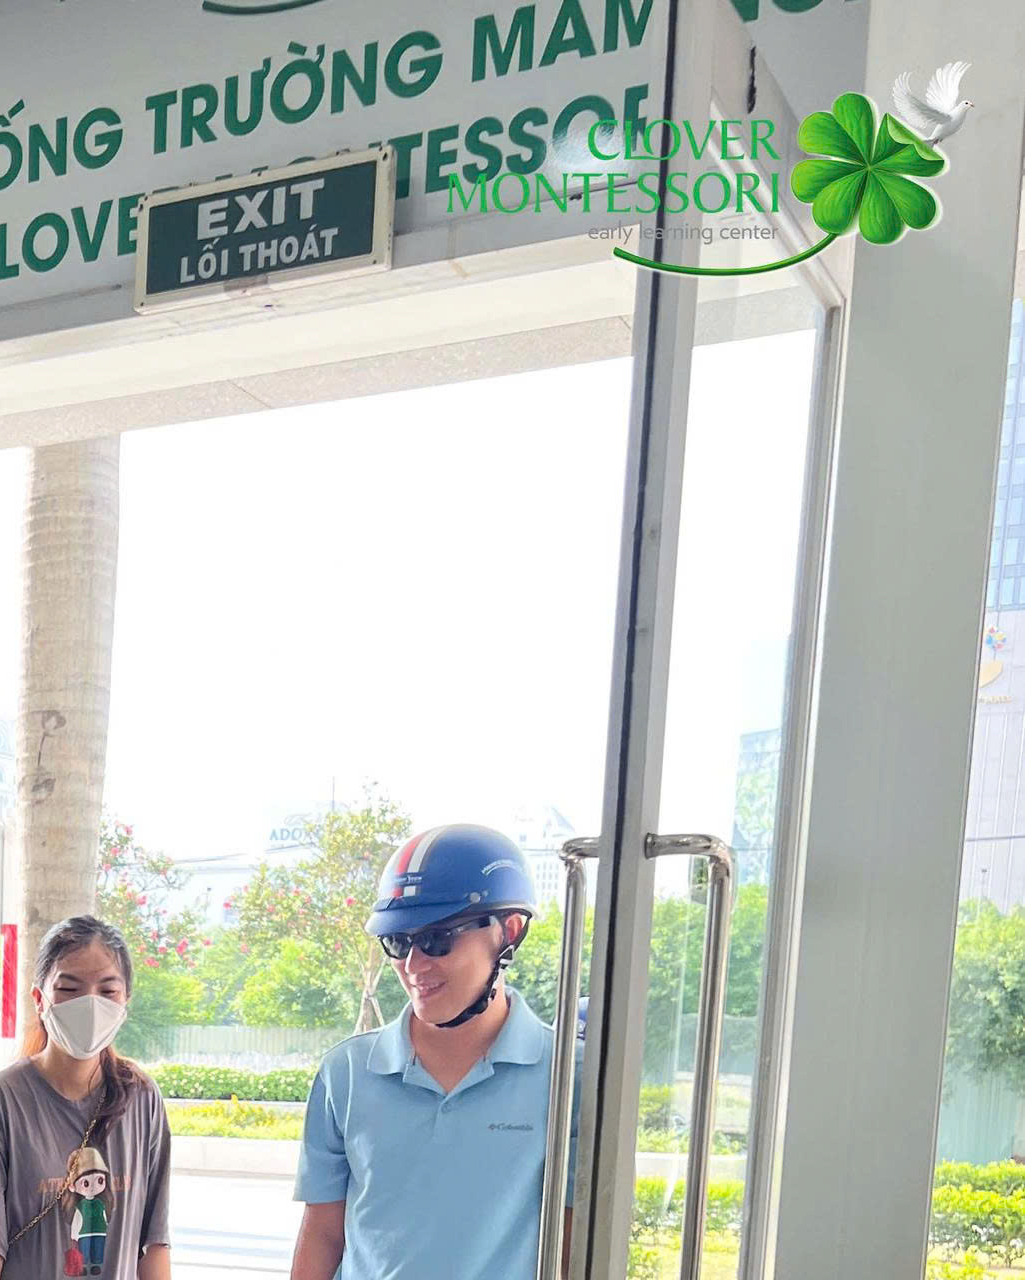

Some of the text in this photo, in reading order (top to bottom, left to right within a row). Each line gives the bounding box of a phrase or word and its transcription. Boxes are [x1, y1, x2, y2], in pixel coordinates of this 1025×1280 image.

[145, 30, 443, 155] TRƯỜNG
[197, 178, 325, 240] EXIT
[179, 224, 339, 284] LỐI THOÁT
